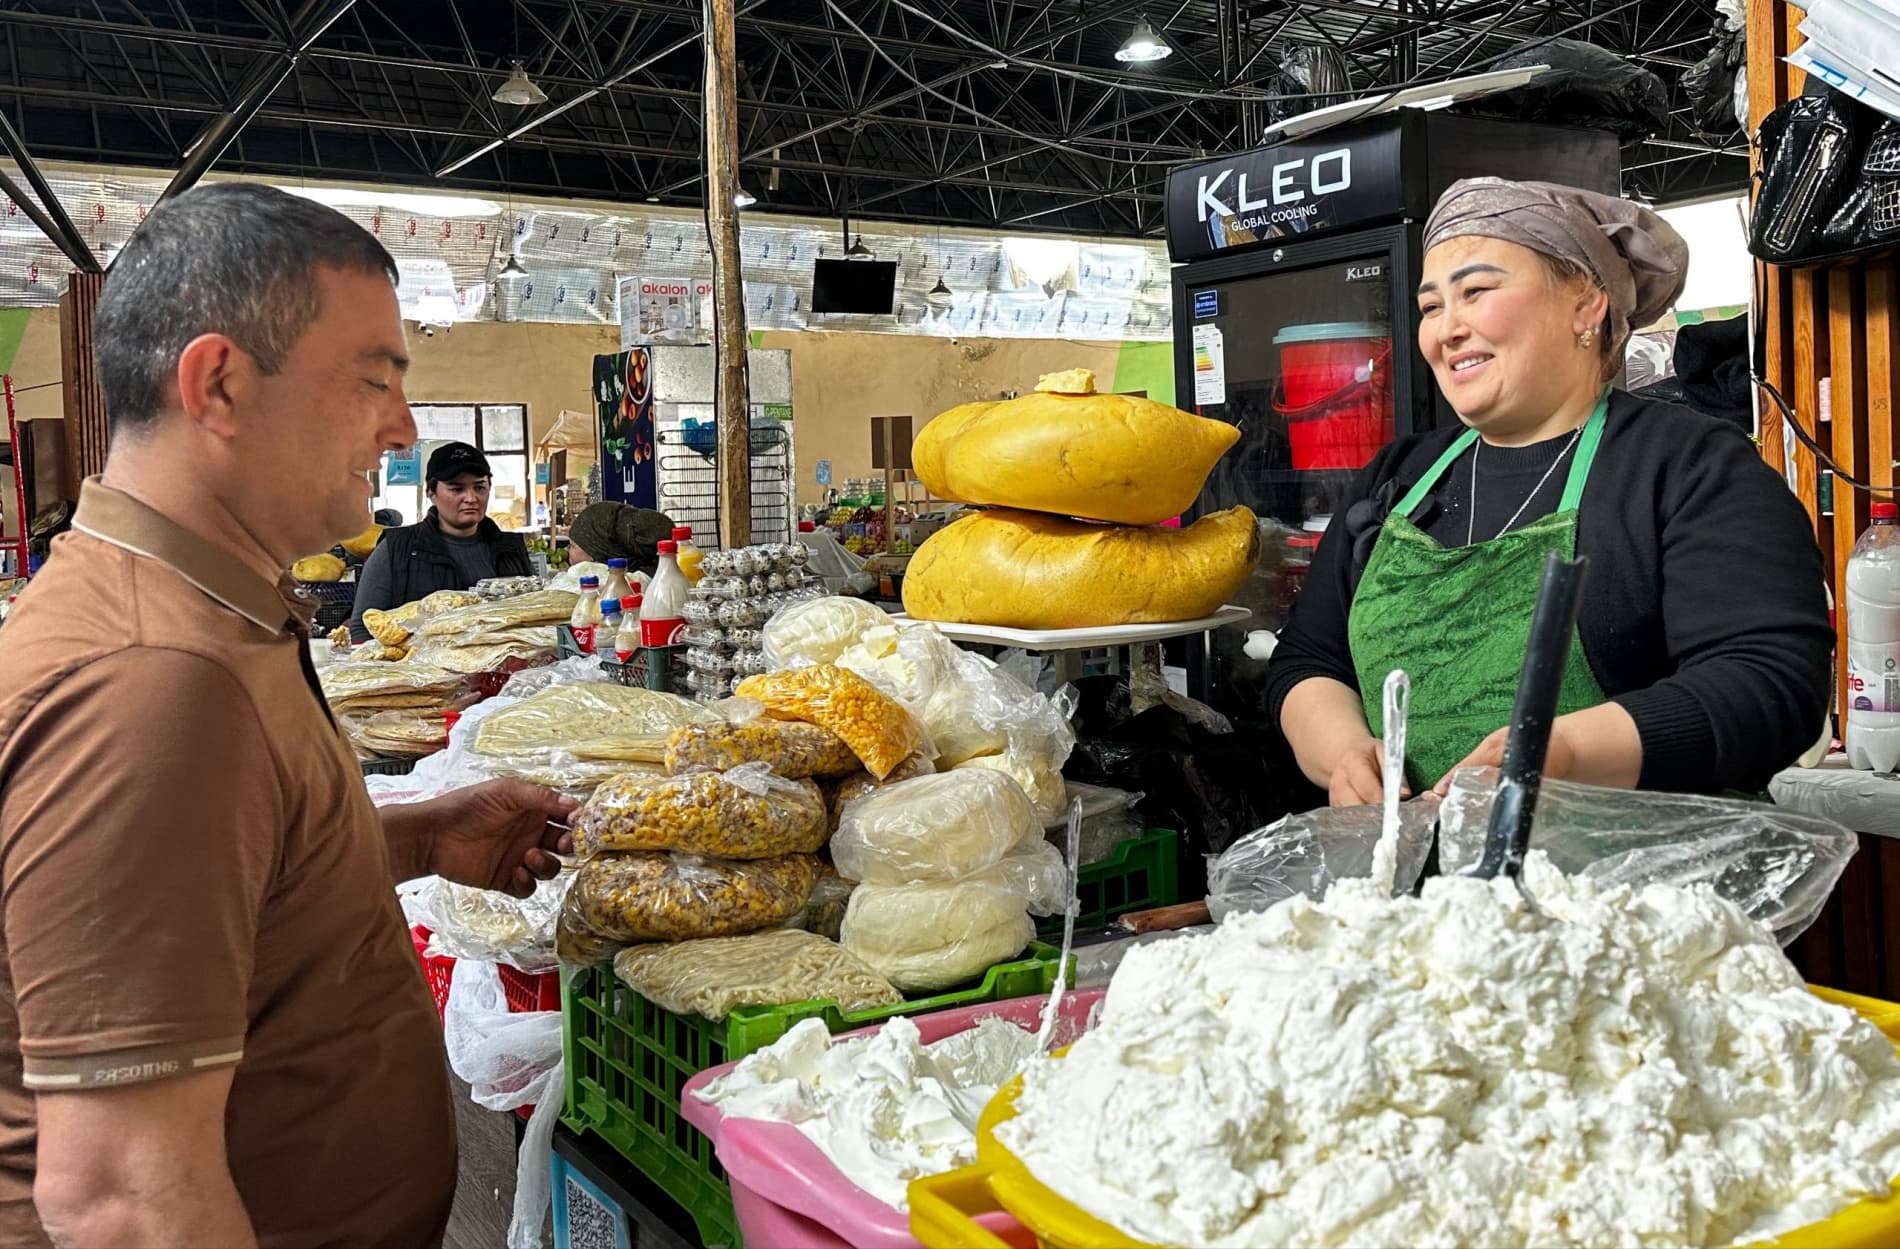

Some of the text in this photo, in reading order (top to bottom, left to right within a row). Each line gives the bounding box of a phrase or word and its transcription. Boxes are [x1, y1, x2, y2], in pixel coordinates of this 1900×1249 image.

[1198, 148, 1351, 222] KLEO
[1231, 203, 1318, 231] GLOBAL COOLING
[1347, 265, 1381, 280] KLEO
[641, 283, 688, 295] akalon
